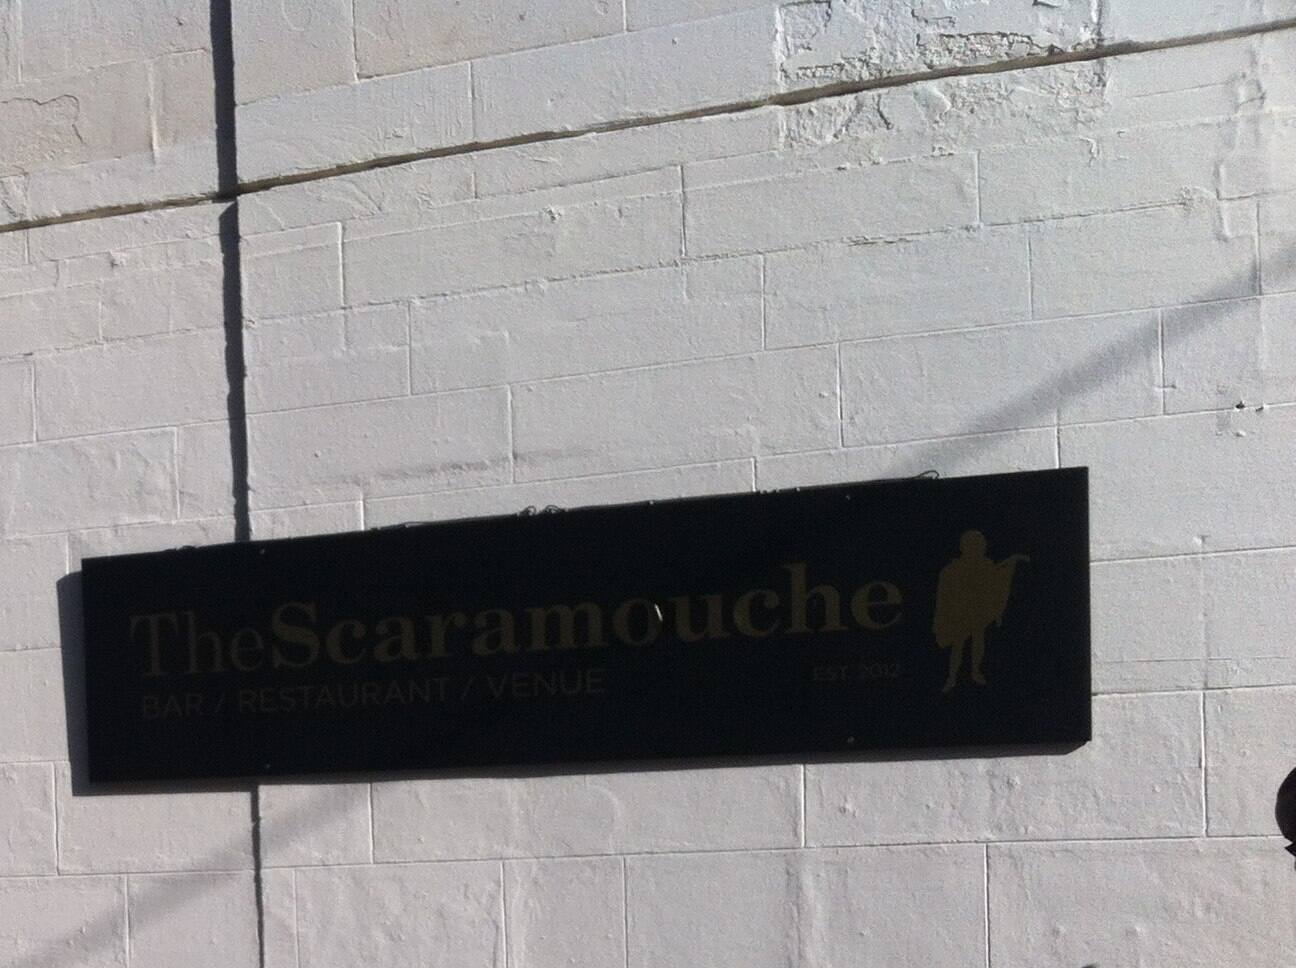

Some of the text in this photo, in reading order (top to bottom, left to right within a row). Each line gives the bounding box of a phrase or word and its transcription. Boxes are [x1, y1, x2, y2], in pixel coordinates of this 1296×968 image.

[142, 692, 203, 719] BAR
[239, 677, 452, 714] RESTAURANT
[487, 667, 606, 700] VENUE
